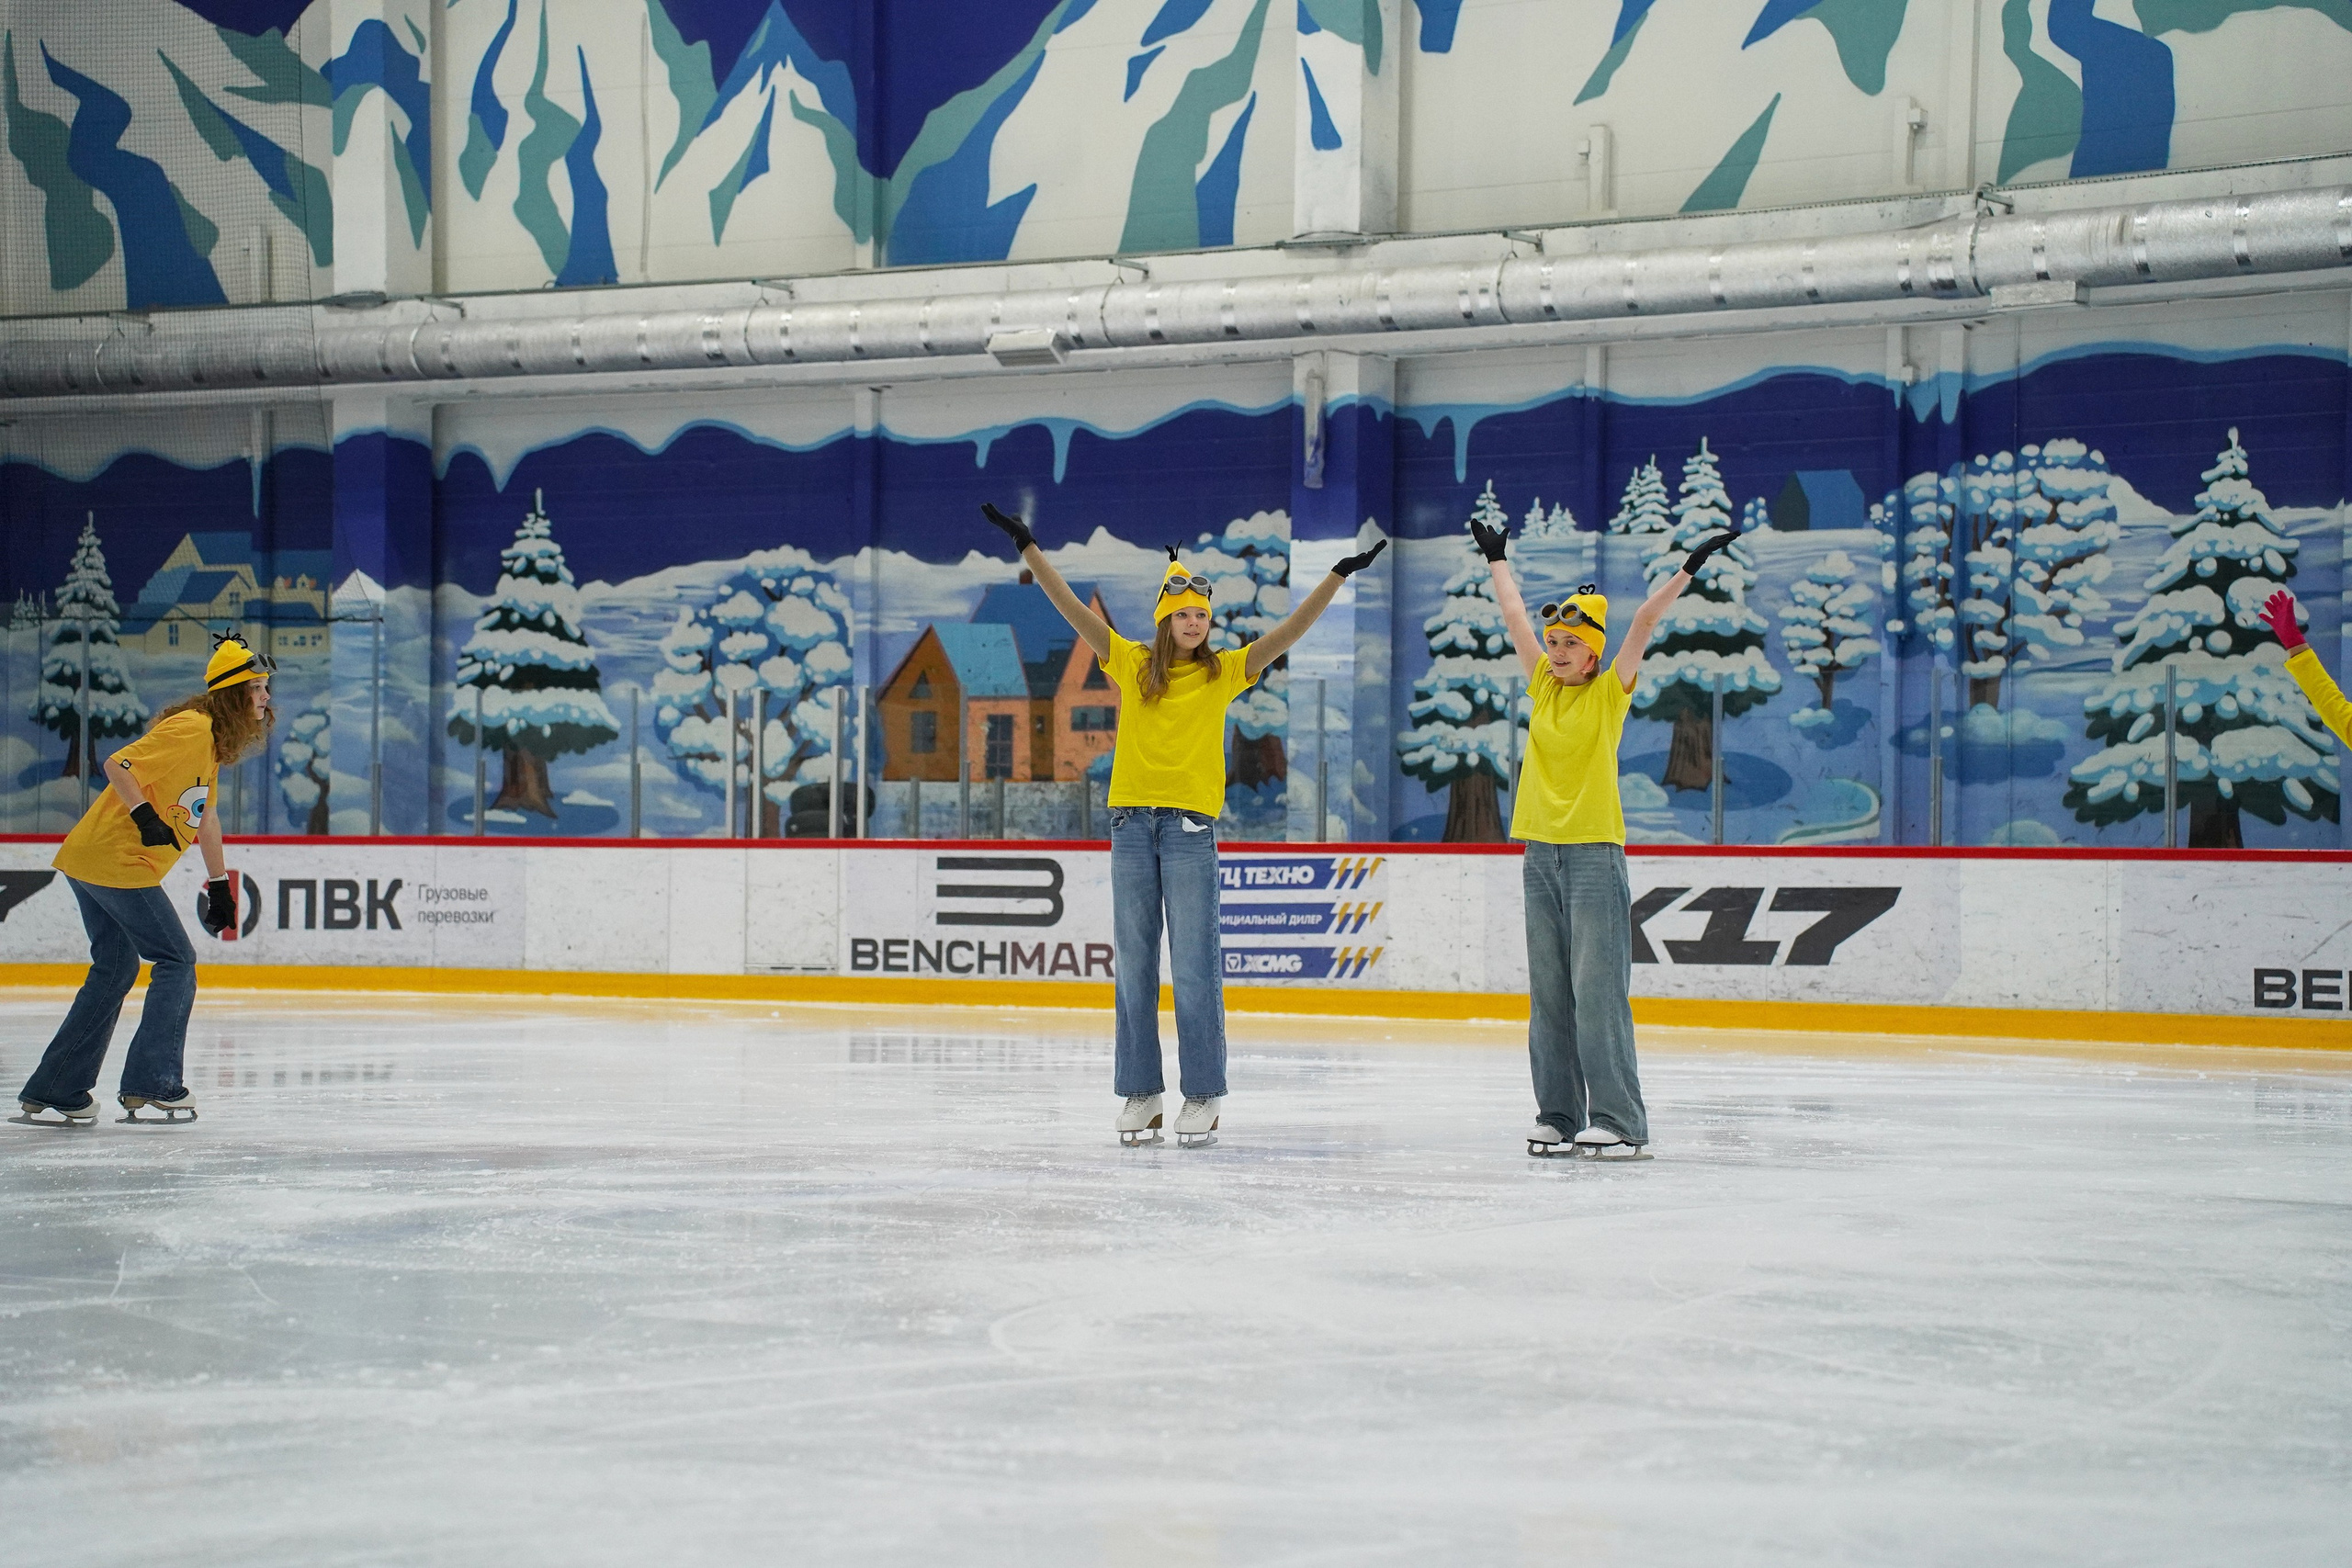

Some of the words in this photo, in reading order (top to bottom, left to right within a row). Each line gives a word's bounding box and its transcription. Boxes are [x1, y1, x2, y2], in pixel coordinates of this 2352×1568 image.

[1244, 865, 1315, 886] ТЕХНО
[277, 878, 403, 931] ПВК
[417, 884, 488, 905] Грузовые
[417, 910, 494, 926] перевозки
[1288, 914, 1323, 927] ДИЛЕР
[1243, 953, 1303, 973] XCMG
[2254, 967, 2352, 1010] BE
